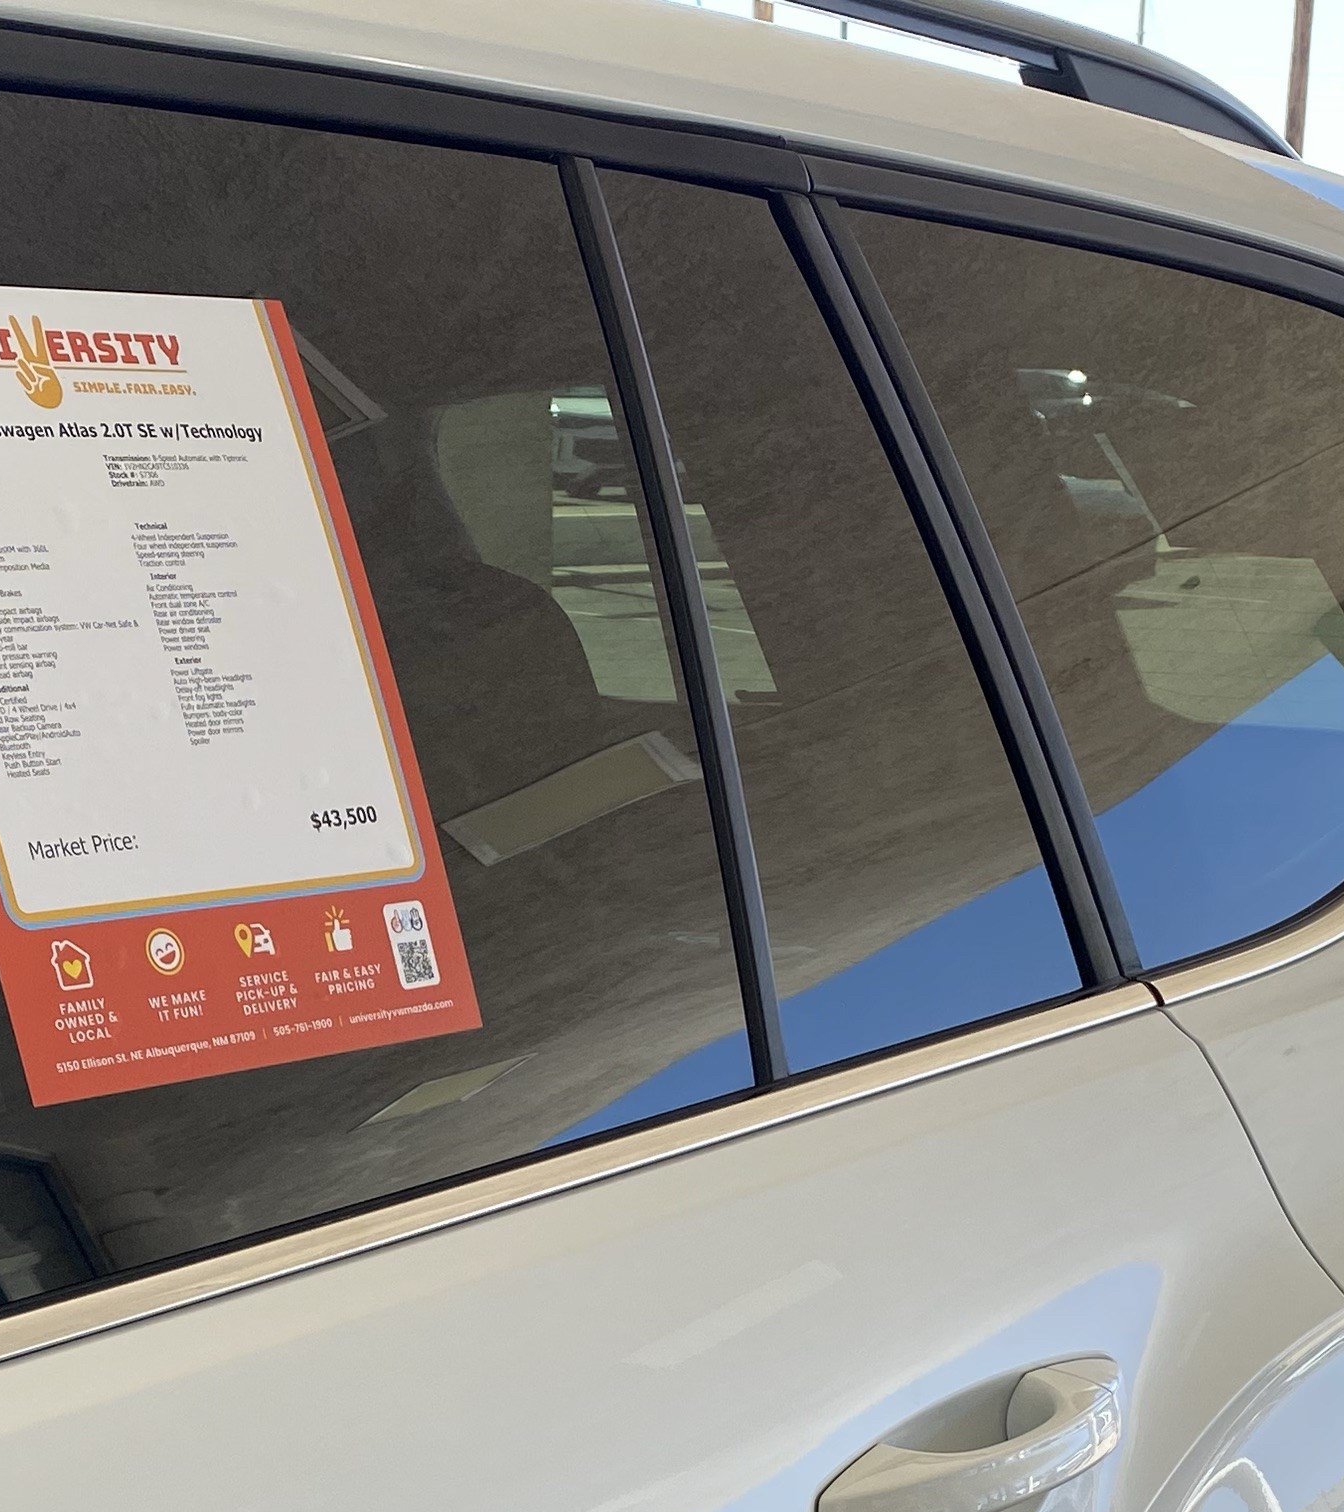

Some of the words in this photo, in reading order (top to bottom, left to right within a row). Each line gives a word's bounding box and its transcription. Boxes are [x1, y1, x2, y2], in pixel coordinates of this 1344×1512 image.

[73, 380, 197, 397] SIMPLE.FAIR.EASY.
[58, 422, 98, 439] Atlas
[102, 422, 133, 439] 2.0T
[138, 423, 157, 439] SE
[159, 423, 263, 443] w/Technology
[103, 454, 151, 462] Transmission:
[178, 454, 207, 462] Automatic
[209, 454, 221, 462] with
[134, 522, 168, 530] Technical
[158, 533, 195, 542] Independent
[196, 533, 229, 541] Suspension
[133, 542, 148, 550] Four
[168, 541, 205, 550] independent
[205, 541, 238, 549] suspension
[136, 550, 180, 560] Speed-sensing
[181, 550, 205, 559] steering
[30, 562, 50, 571] Media
[139, 559, 164, 567] Traction
[165, 558, 186, 567] control
[0, 589, 23, 597] Brakes
[180, 591, 216, 600] temperature
[217, 590, 237, 598] control
[19, 606, 43, 616] airbags
[13, 615, 35, 625] impact
[36, 614, 60, 623] airbags
[3, 624, 53, 634] communication
[54, 623, 78, 632] system:
[79, 622, 91, 630] VW
[93, 621, 117, 630] Car-Net
[118, 620, 133, 628] Safe
[2, 652, 30, 662] pressure
[32, 651, 58, 660] warning
[174, 657, 202, 665] Exterior
[9, 661, 34, 670] sensing
[35, 660, 56, 669] airbag
[12, 670, 34, 679] airbag
[0, 696, 28, 705] Certified
[4, 715, 20, 724] Row
[20, 714, 46, 723] Seating
[11, 724, 36, 733] Backup
[36, 722, 62, 731] Camera
[189, 737, 210, 746] Spoiler
[1, 752, 27, 761] Keyless
[27, 750, 46, 759] Entry
[4, 761, 21, 769] Push
[22, 759, 45, 768] Button
[45, 758, 61, 766] Start
[6, 770, 31, 779] Heated
[32, 768, 51, 776] Seats
[309, 805, 378, 832] $43,500
[28, 836, 89, 861] Market
[92, 834, 139, 854] Price:
[239, 971, 290, 988] SERVICE
[315, 969, 341, 984] FAIR
[343, 968, 352, 979] &
[354, 964, 382, 978] EASY
[328, 978, 375, 995] PRICING
[235, 986, 284, 1002] PICK-UP
[285, 984, 298, 995] &
[148, 995, 172, 1009] WE
[173, 990, 207, 1006] MAKE
[59, 997, 106, 1016] FAMILY
[242, 997, 298, 1016] DELIVERY
[158, 1010, 170, 1022] IT
[172, 1004, 205, 1021] FUN!
[54, 1013, 106, 1032] OWNED
[108, 1010, 119, 1024] &
[69, 1027, 112, 1044] LOCAL
[56, 1060, 80, 1074] 5150
[81, 1054, 115, 1070] Ellison
[130, 1050, 144, 1061] NE
[146, 1038, 212, 1059] Albuquerque,
[213, 1034, 229, 1046] NM
[230, 1029, 256, 1043] 87109
